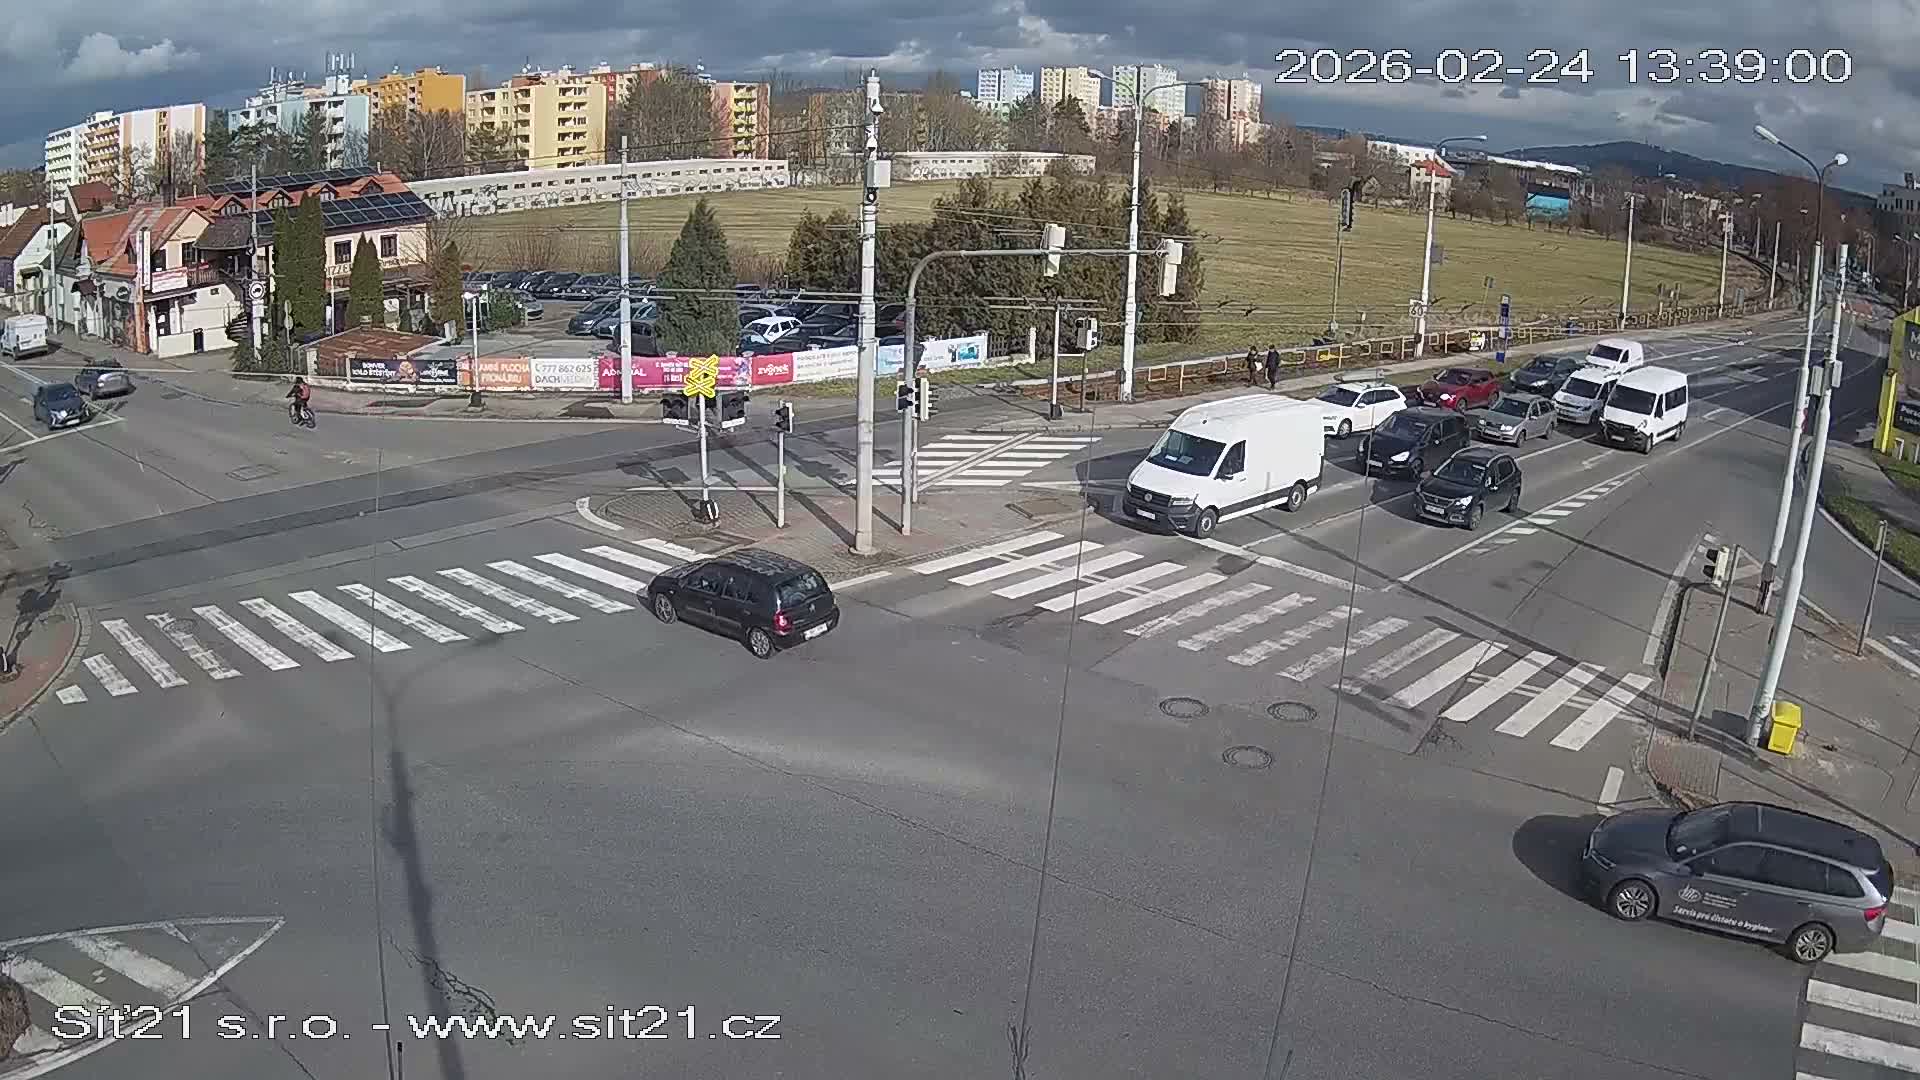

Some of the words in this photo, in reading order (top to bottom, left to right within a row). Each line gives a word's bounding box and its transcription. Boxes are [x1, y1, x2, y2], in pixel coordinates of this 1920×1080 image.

[542, 364, 557, 373] 777
[575, 364, 592, 373] 625
[1673, 905, 1697, 917] Servis
[1696, 911, 1710, 920] pro
